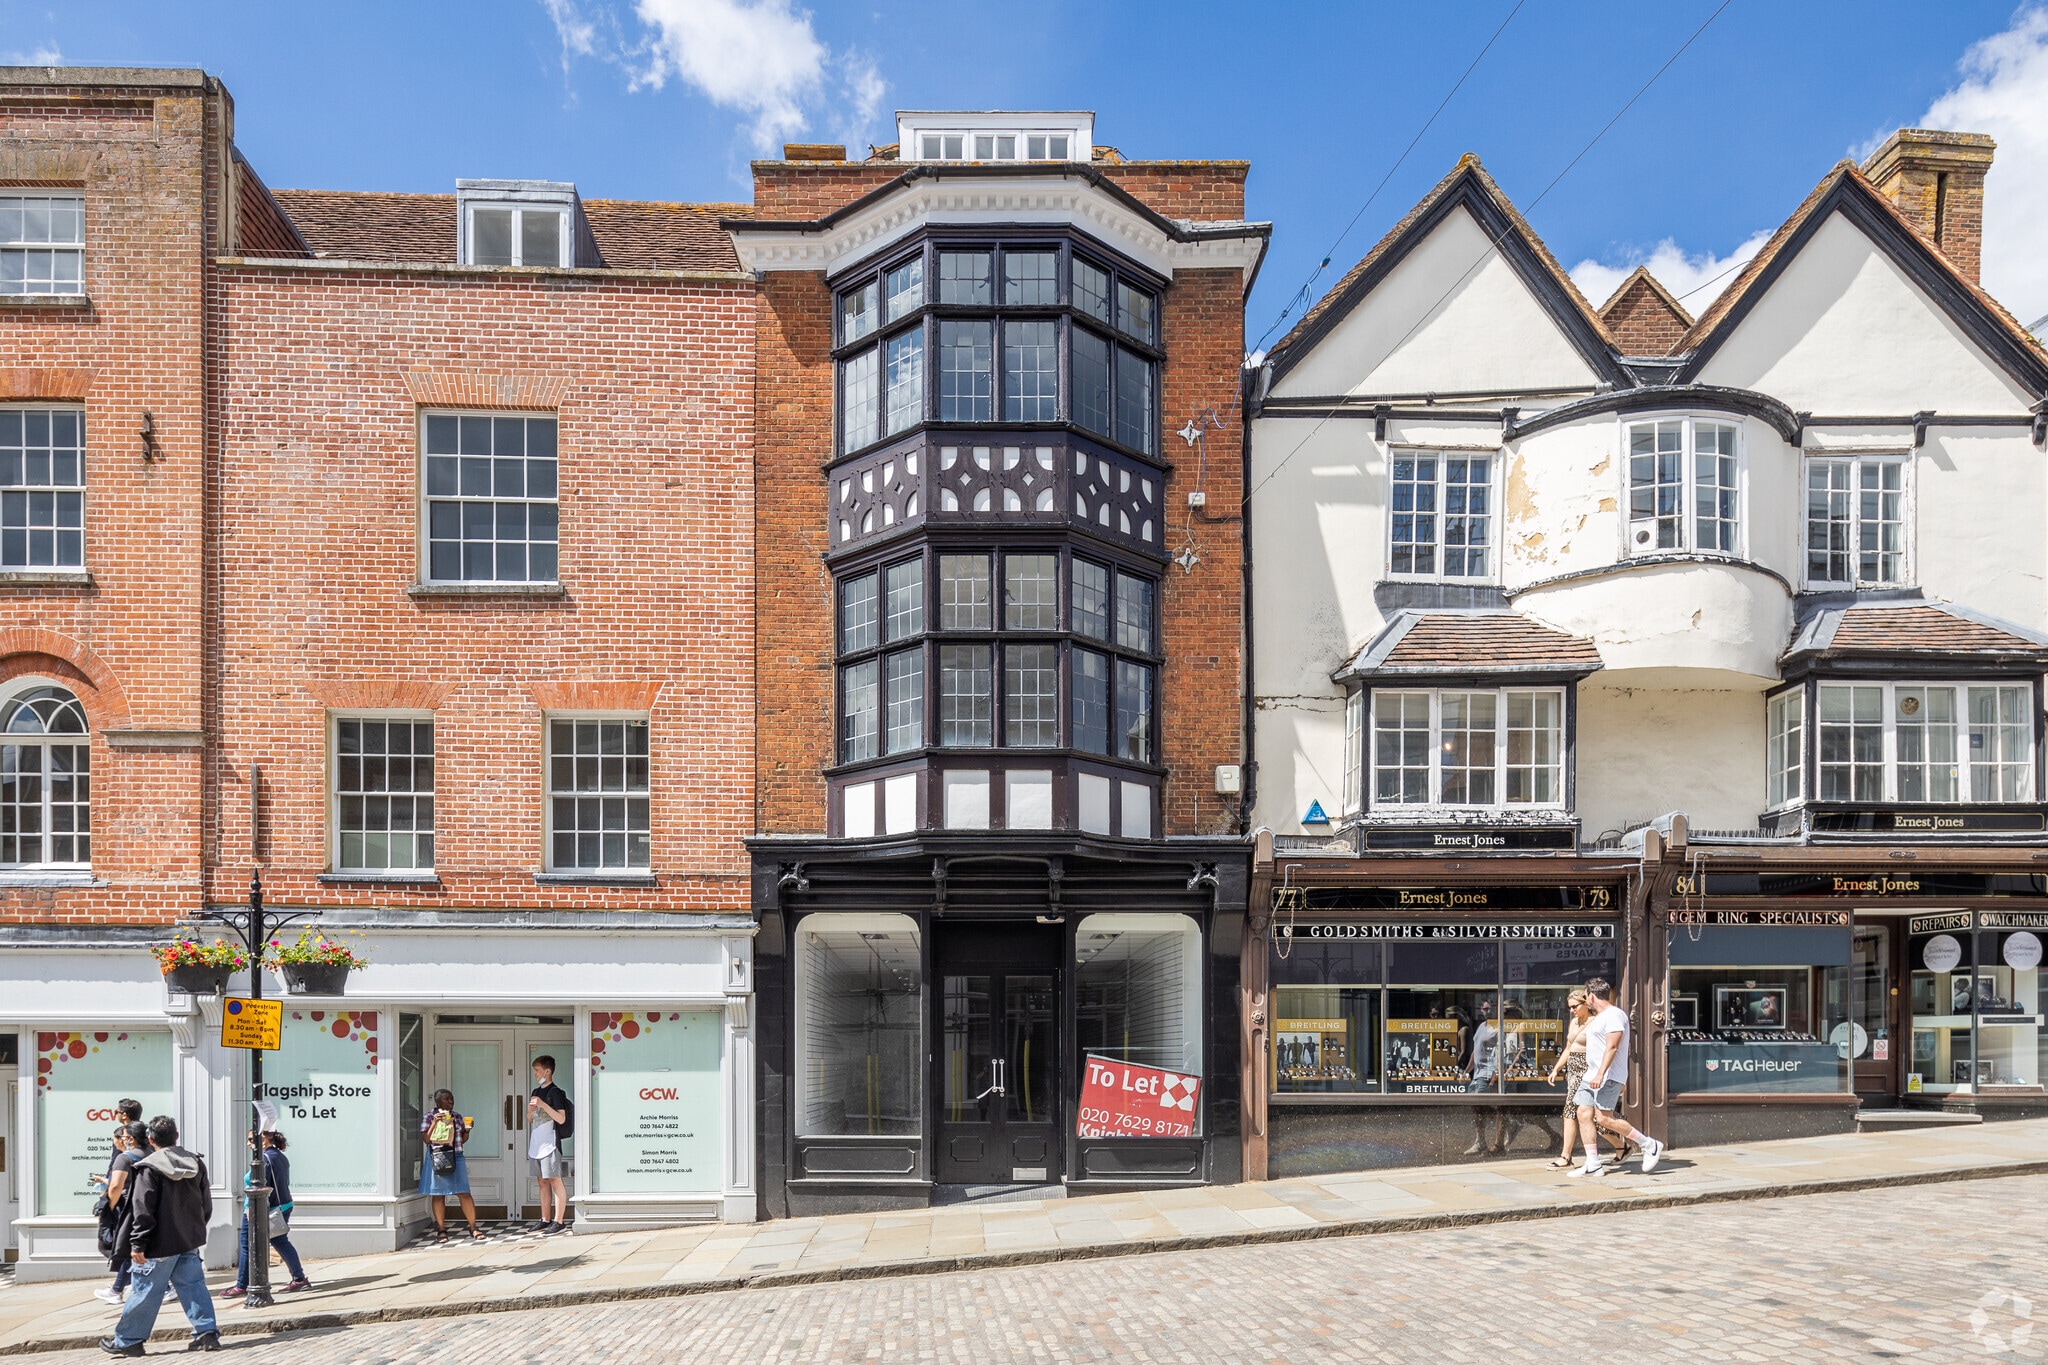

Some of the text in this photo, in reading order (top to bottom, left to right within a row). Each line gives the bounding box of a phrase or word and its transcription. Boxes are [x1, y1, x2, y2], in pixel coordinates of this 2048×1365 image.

[1895, 816, 1964, 830] Ernest Jones
[1434, 834, 1505, 848] Ernest Jones
[1833, 877, 1920, 894] Ernest Jones
[1400, 891, 1488, 907] Ernest Jones
[1590, 889, 1610, 907] 79
[1679, 912, 1707, 924] GEM
[1717, 912, 1749, 924] RING
[1760, 911, 1839, 924] SPECIALISTS
[1922, 915, 1960, 931] REPAIRS
[1311, 926, 1424, 937] GOLDSMITHS
[1432, 927, 1440, 937] &
[1448, 926, 1576, 937] SILVERSMITHS
[1401, 1022, 1451, 1030] BREITLING
[1507, 1022, 1556, 1030] BREITLING
[1090, 1064, 1159, 1096] To Let
[263, 1083, 371, 1099] lagship Store
[1406, 1085, 1466, 1093] BREITLING
[289, 1105, 307, 1118] To
[312, 1105, 337, 1119] Let
[1081, 1108, 1189, 1136] 020 7629 8171
